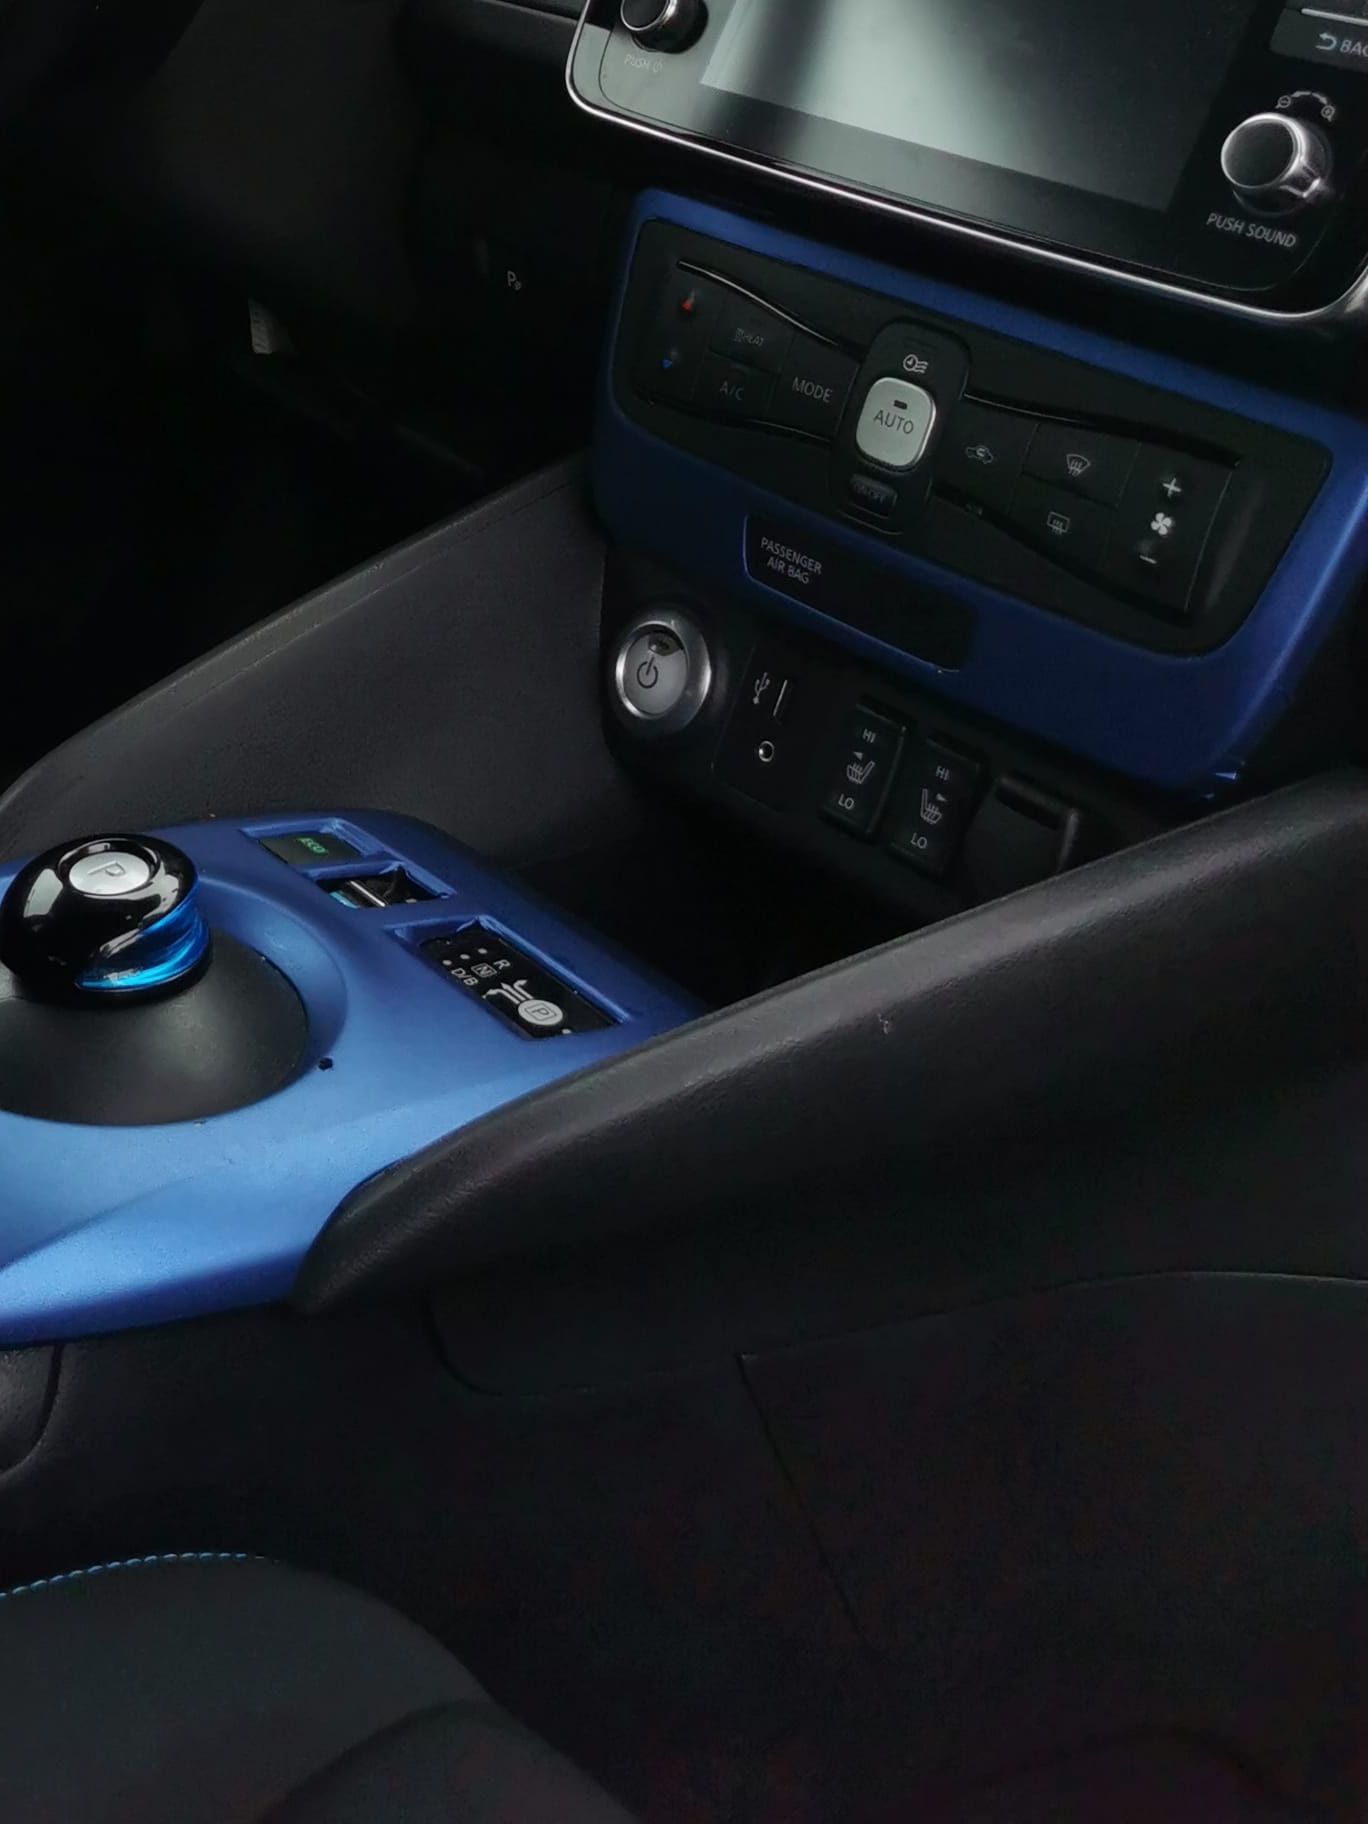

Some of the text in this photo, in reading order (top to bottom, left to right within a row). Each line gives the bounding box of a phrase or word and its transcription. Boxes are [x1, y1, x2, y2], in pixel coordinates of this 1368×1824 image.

[1205, 212, 1297, 248] PUSH SOUND
[719, 380, 745, 401] A/C
[792, 376, 833, 404] MODE
[873, 409, 914, 434] AUTO
[760, 536, 823, 575] PASSENGER
[766, 556, 810, 585] AIR BAG
[862, 728, 876, 743] HI
[935, 765, 950, 781] HI
[838, 793, 855, 810] LO
[296, 837, 328, 855] ECO
[910, 832, 928, 849] LO
[87, 860, 127, 877] P
[493, 959, 511, 970] R
[451, 967, 479, 987] D/B
